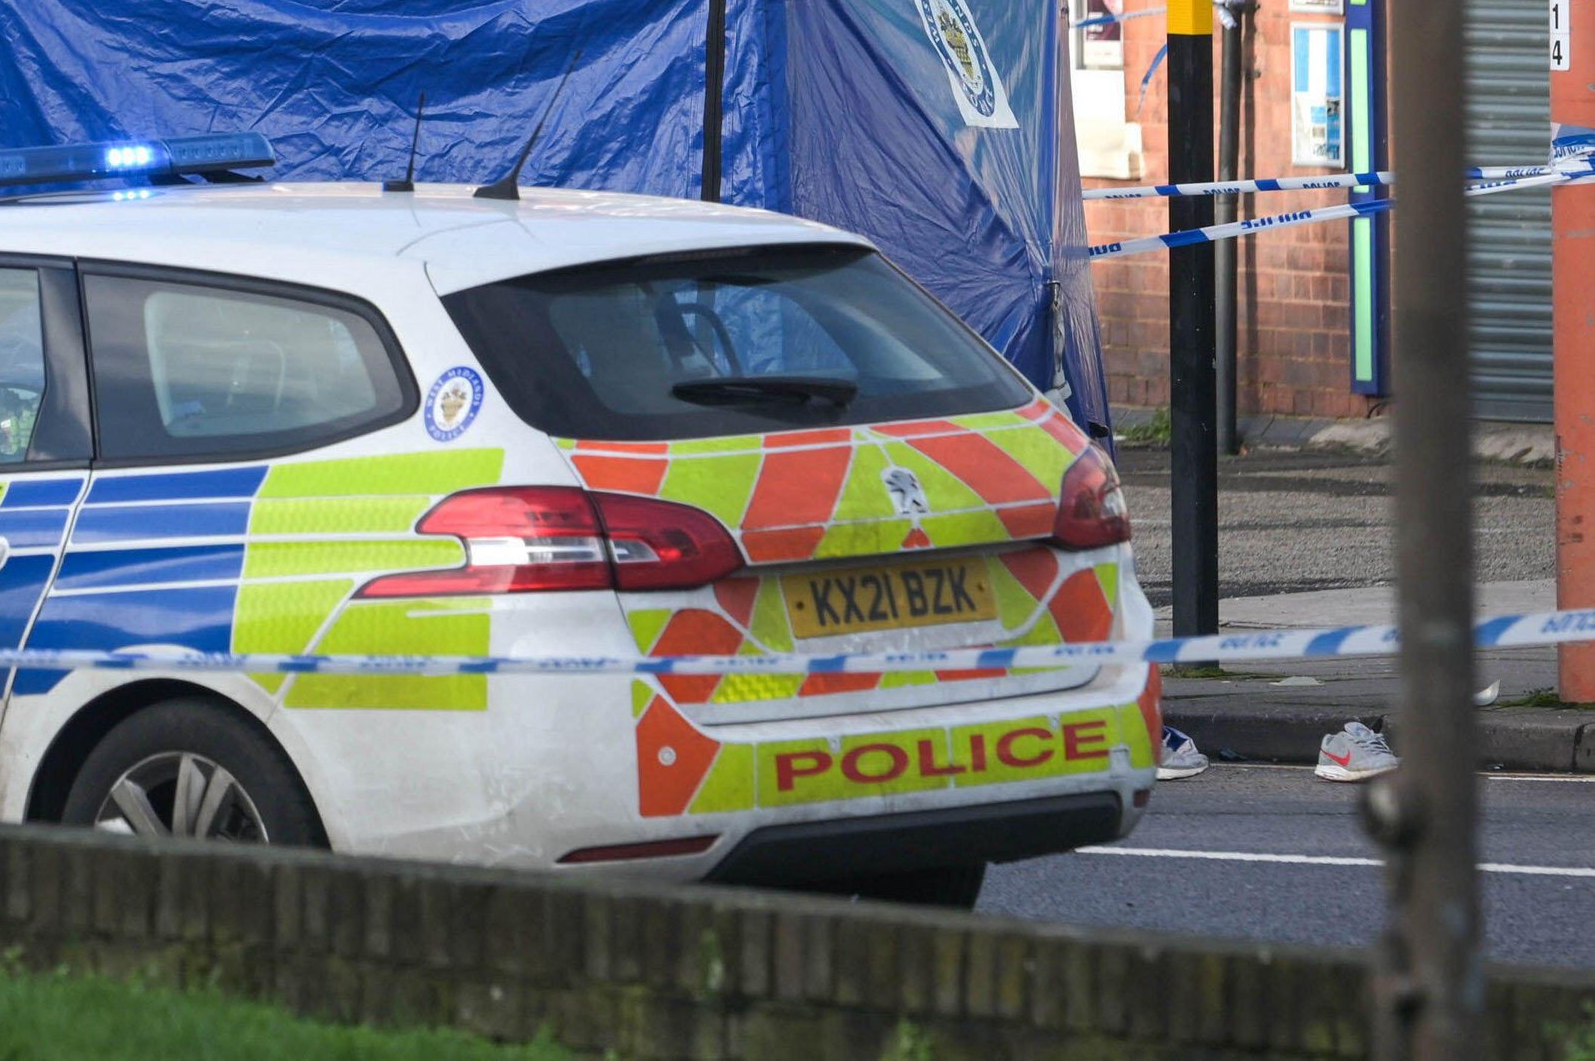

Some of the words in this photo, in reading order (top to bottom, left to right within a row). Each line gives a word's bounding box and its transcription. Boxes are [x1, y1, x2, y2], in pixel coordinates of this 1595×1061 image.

[810, 572, 899, 626] KX21
[900, 565, 976, 617] BZK
[774, 720, 1110, 792] POLICE
